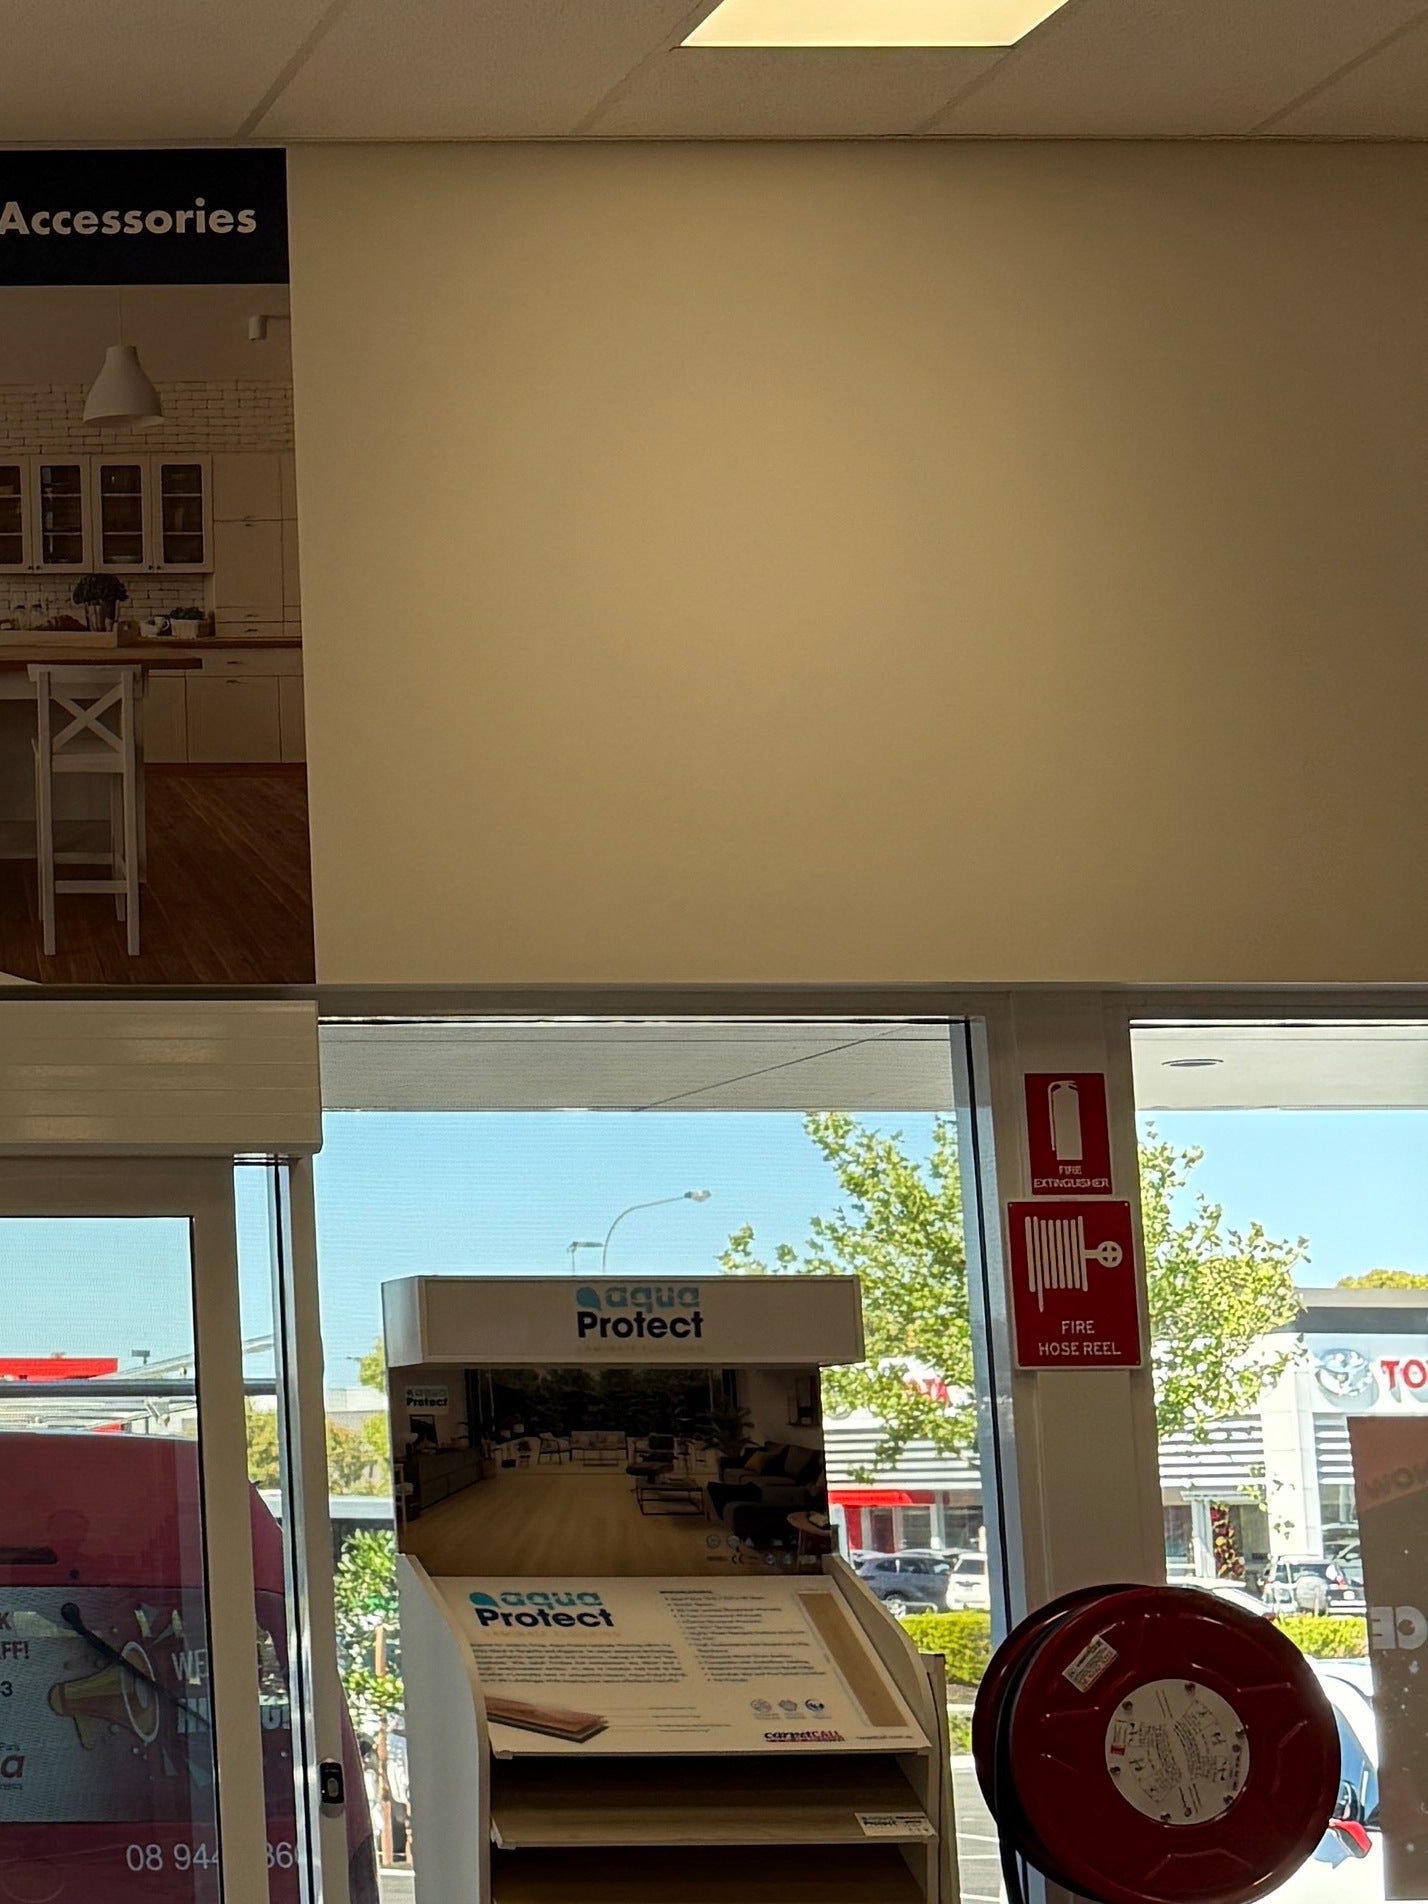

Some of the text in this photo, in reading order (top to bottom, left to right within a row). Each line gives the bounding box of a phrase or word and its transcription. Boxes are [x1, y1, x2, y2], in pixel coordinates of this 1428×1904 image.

[1058, 1165, 1082, 1175] FIRE
[1033, 1178, 1110, 1188] EXTINGUISHER
[604, 1286, 701, 1314] aqua
[576, 1311, 704, 1338] Protect
[1061, 1320, 1095, 1335] FIRE
[1038, 1342, 1122, 1356] HOSE REEL
[499, 1591, 603, 1610] aqua
[474, 1607, 615, 1628] Protect
[125, 1843, 164, 1872] 08
